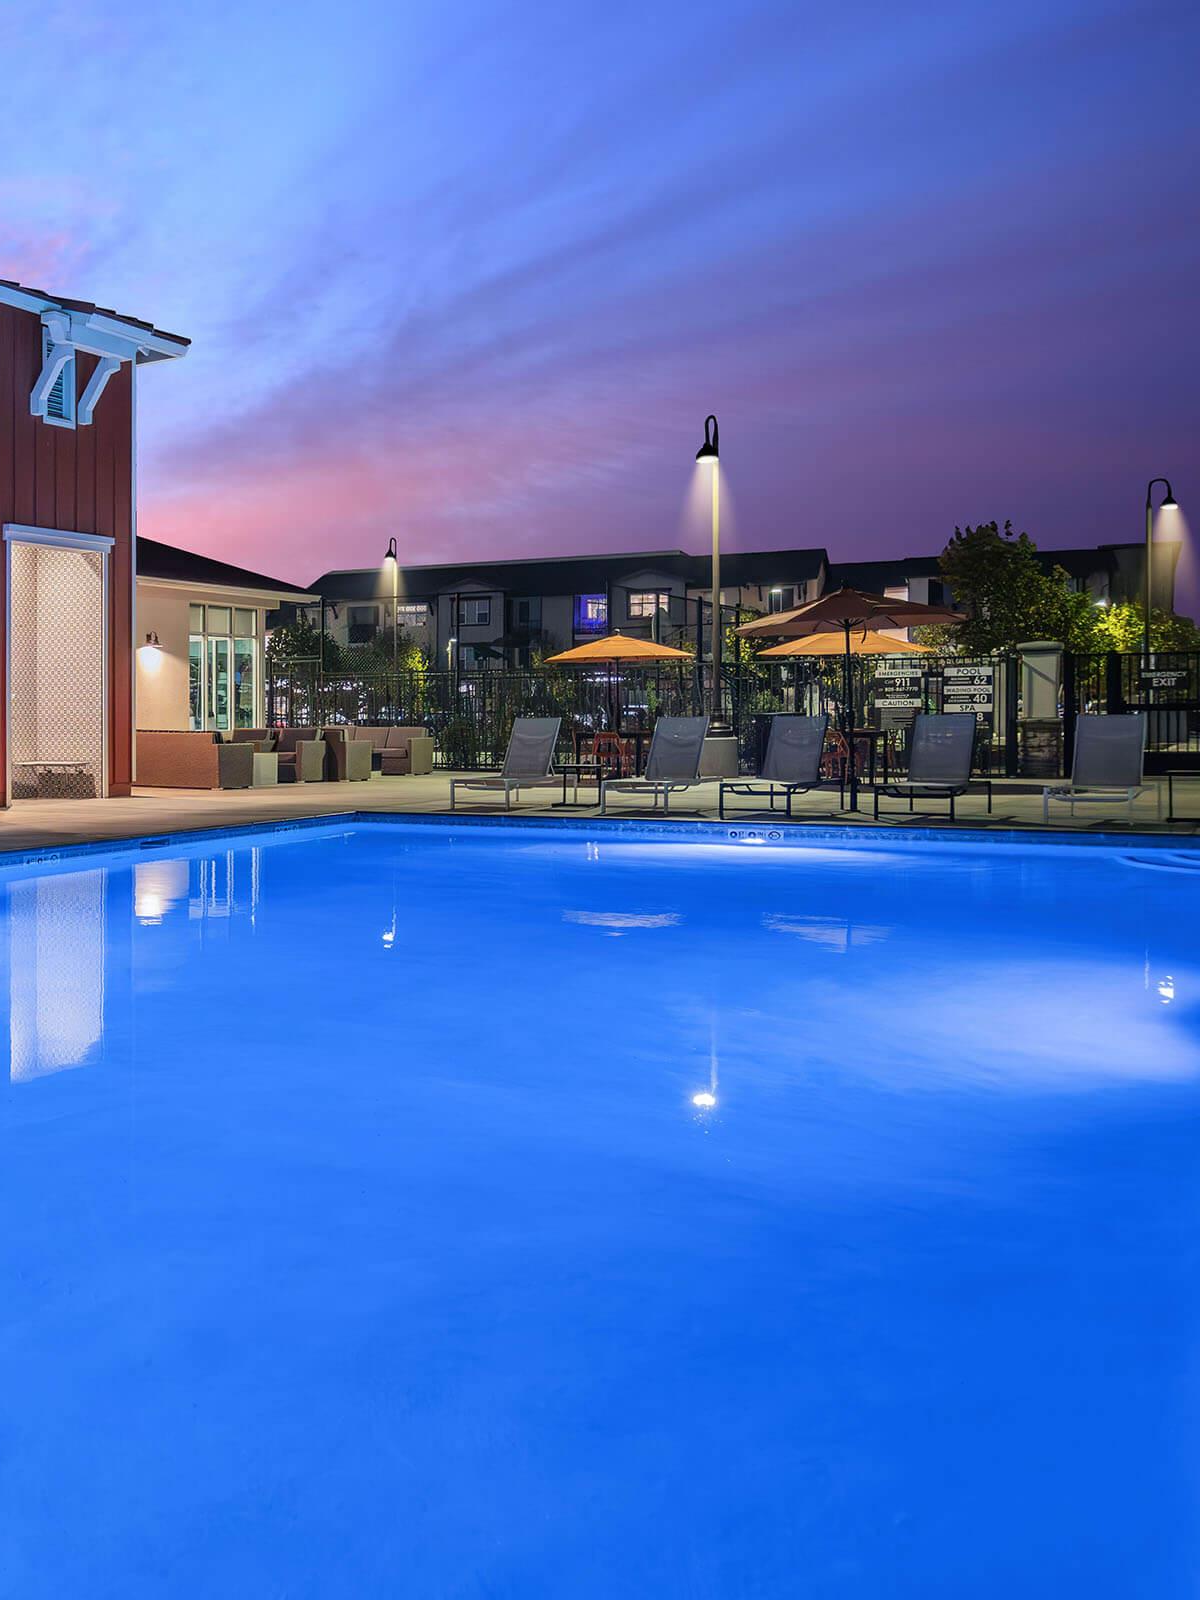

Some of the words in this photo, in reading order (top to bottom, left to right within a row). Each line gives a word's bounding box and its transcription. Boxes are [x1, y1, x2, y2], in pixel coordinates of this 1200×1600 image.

[895, 677, 910, 687] 911
[974, 676, 988, 684] 62
[1152, 677, 1177, 687] EXIT
[973, 694, 988, 704] 40
[976, 712, 984, 721] 8
